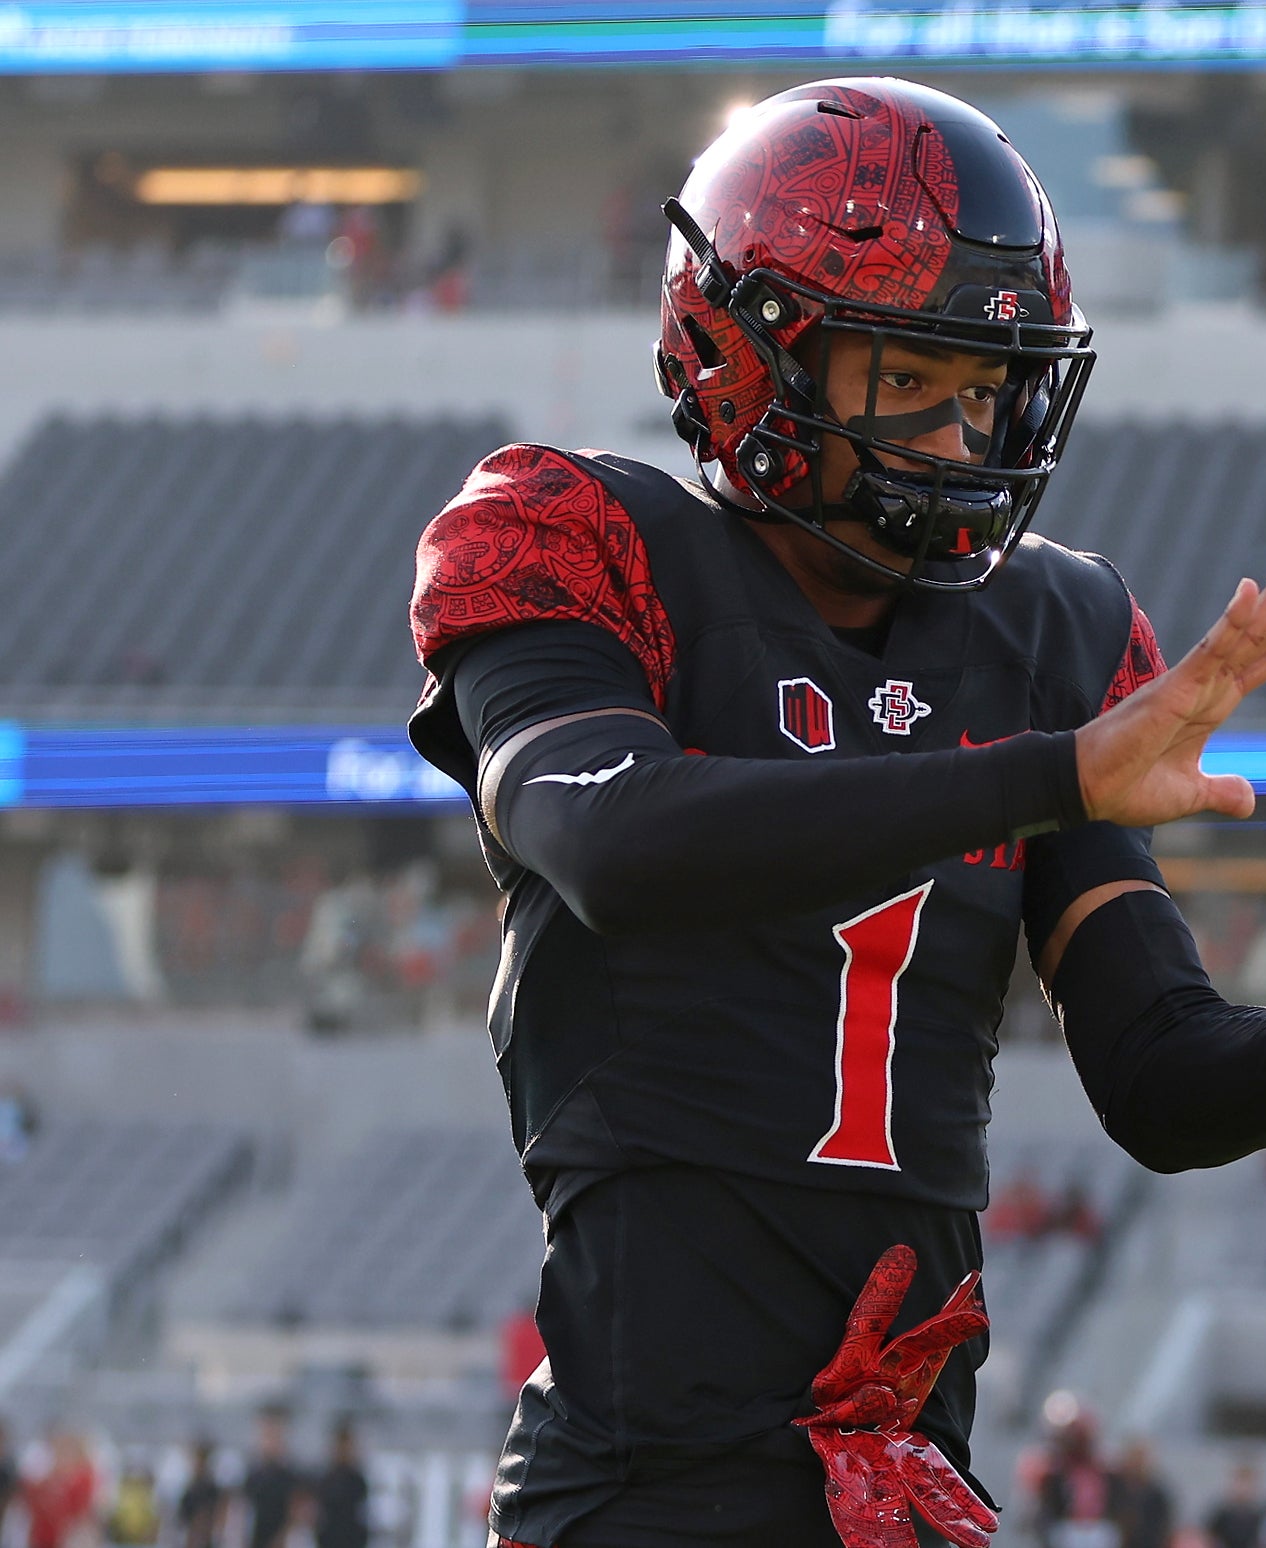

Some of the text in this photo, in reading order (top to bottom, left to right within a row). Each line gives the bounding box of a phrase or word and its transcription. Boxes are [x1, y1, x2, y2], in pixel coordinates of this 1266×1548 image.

[825, 1, 911, 53] For
[919, 1, 976, 54] all
[1139, 2, 1227, 55] San
[806, 878, 935, 1172] 1
